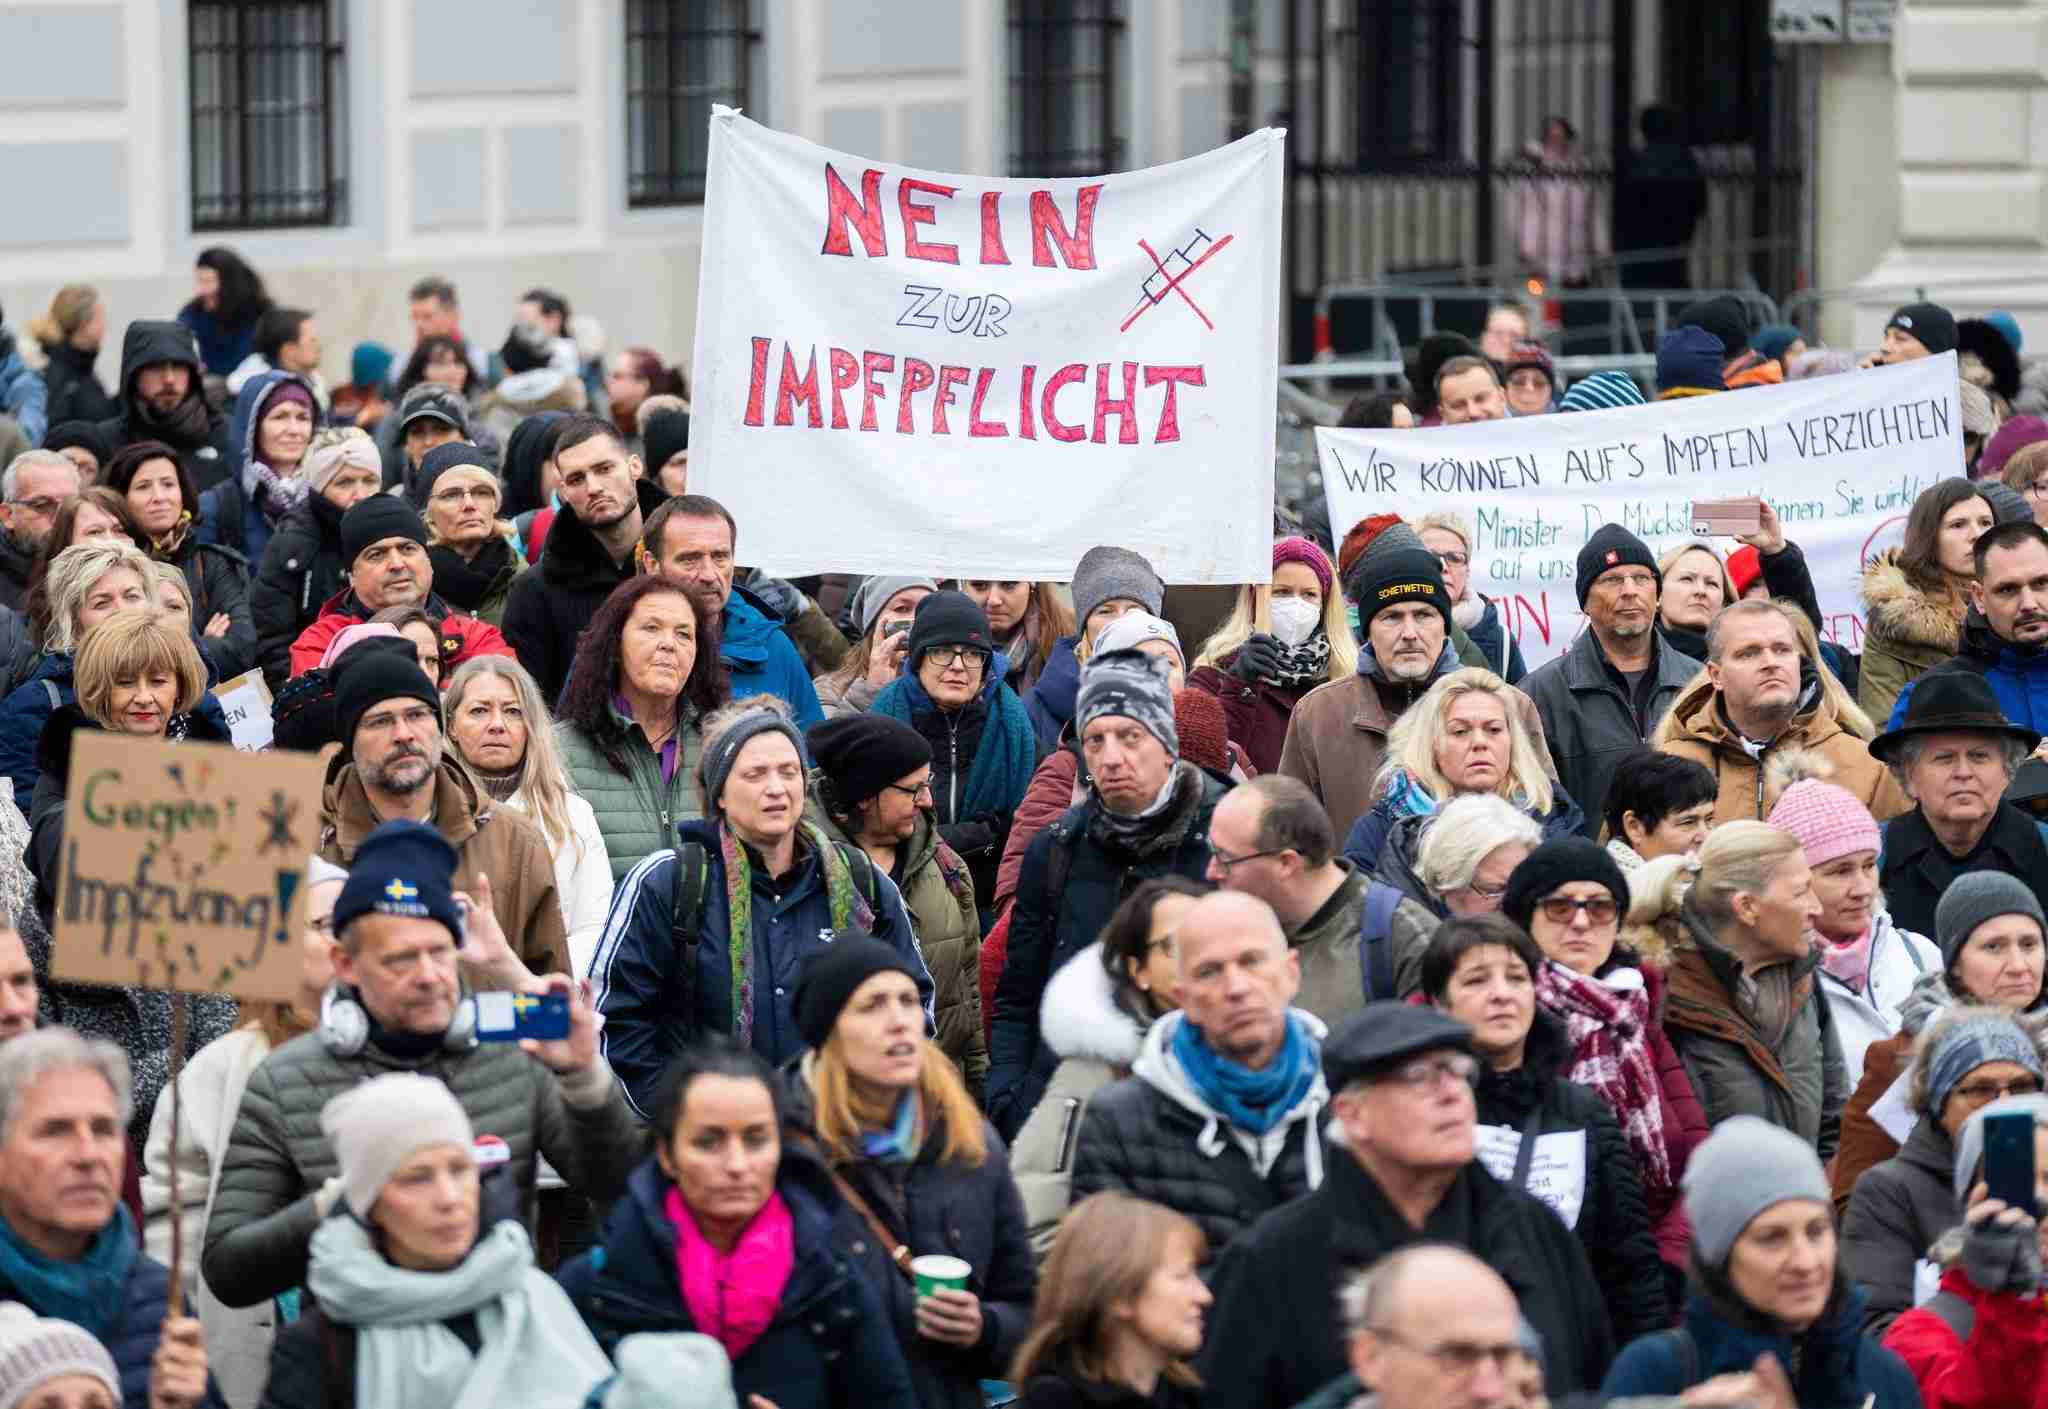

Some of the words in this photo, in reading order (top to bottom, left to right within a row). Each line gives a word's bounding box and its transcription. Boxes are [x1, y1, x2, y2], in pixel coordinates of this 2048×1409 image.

[820, 162, 1105, 270] NEIN
[896, 284, 1013, 338] ZUR
[743, 336, 1207, 445] IMPFPFLICHT
[1331, 447, 1398, 493] WIR
[1420, 453, 1540, 493] KÖNNEN
[1564, 442, 1645, 484] AUF'S
[1663, 432, 1769, 475] IMPFEN
[1787, 396, 1952, 459] VERZICHTEN
[1477, 505, 1563, 551] Minister
[1623, 500, 1691, 537] Mückst
[1835, 479, 1865, 517] Sie
[1875, 471, 1940, 511] wirkl
[1490, 552, 1524, 581] auf
[1488, 591, 1550, 648] IN
[82, 767, 218, 845] Gegen
